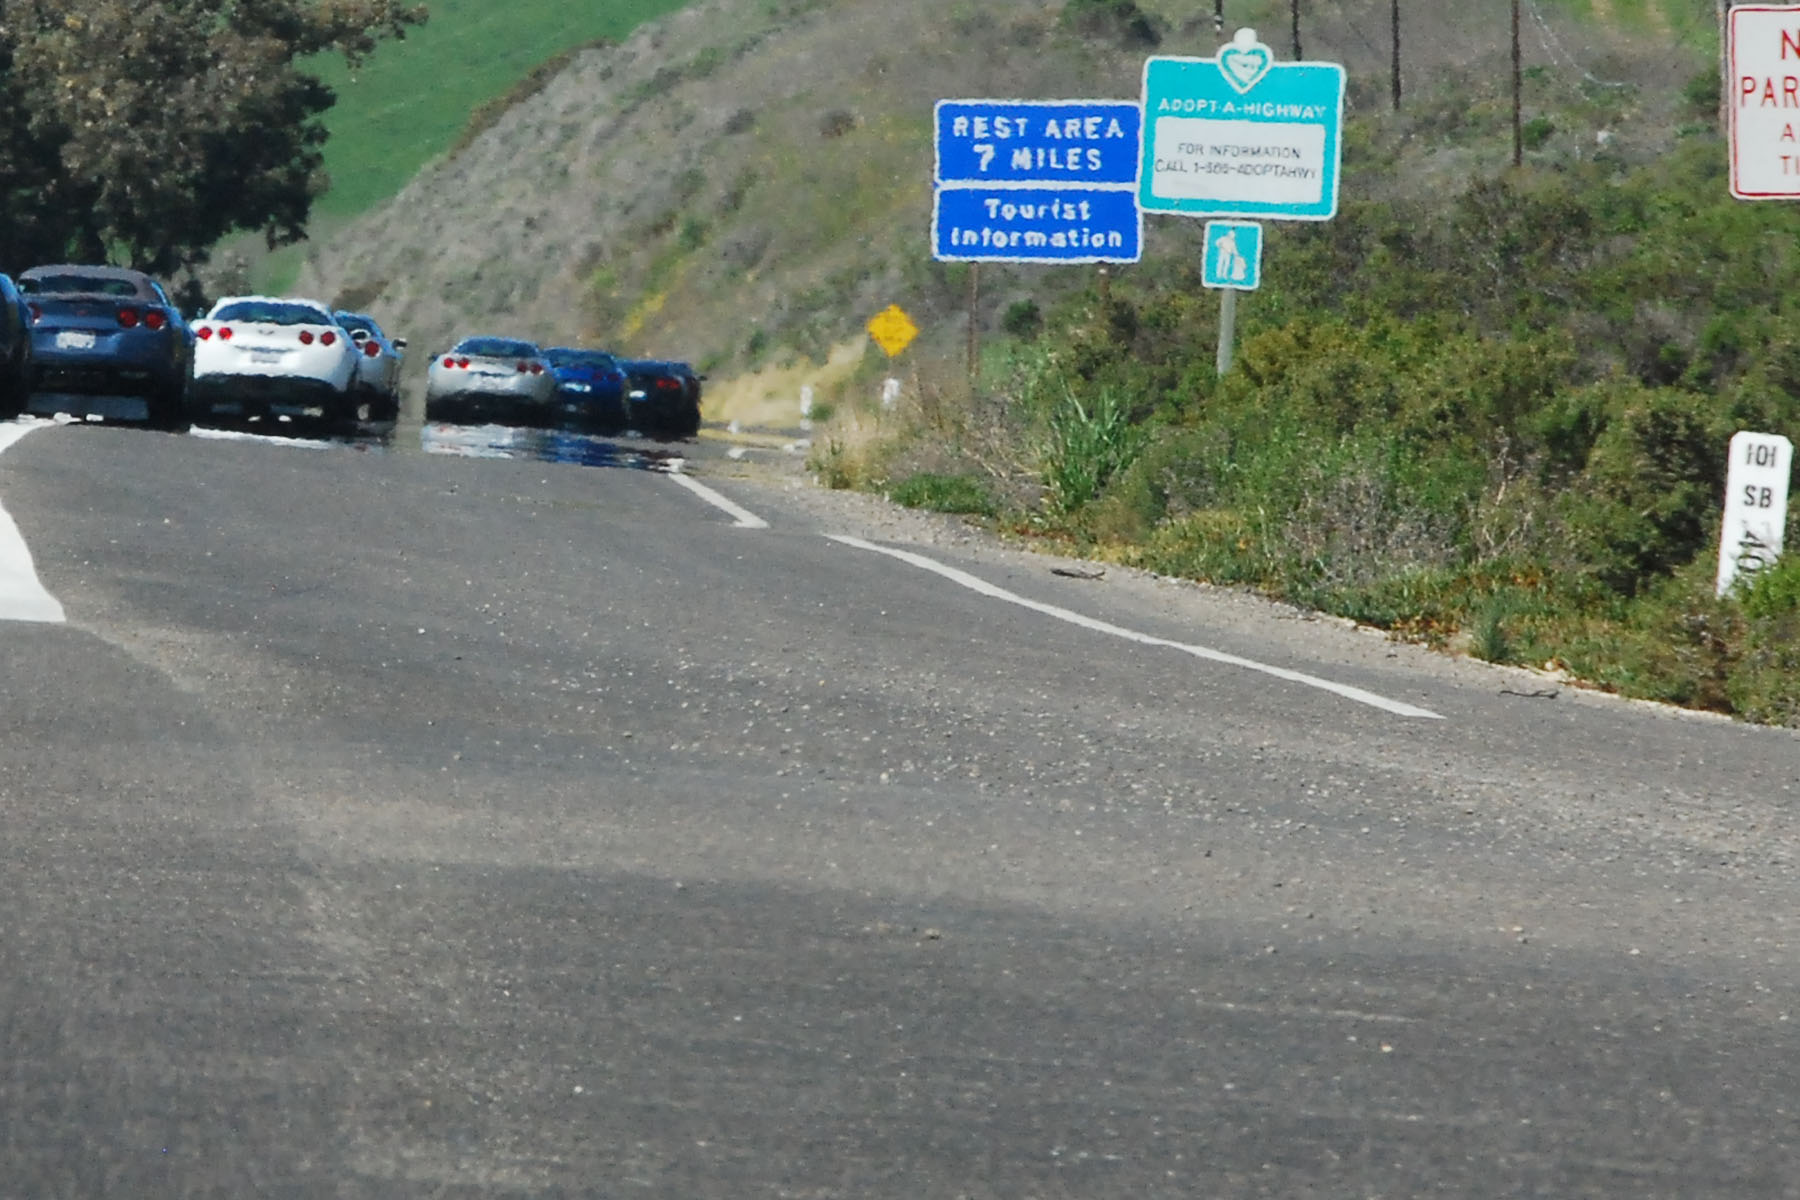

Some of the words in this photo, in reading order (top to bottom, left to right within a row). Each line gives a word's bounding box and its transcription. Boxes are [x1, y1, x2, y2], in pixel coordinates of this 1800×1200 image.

[953, 115, 1029, 139] REST
[1045, 116, 1124, 139] AREA
[973, 143, 995, 172] 7
[1011, 146, 1102, 171] MILES
[1178, 142, 1204, 155] FOR
[1210, 144, 1301, 159] INFORMATION
[1154, 159, 1188, 173] CALL
[984, 198, 1091, 220] Tourist
[951, 227, 1122, 248] Information
[1746, 443, 1777, 467] 101
[1743, 485, 1773, 508] SB
